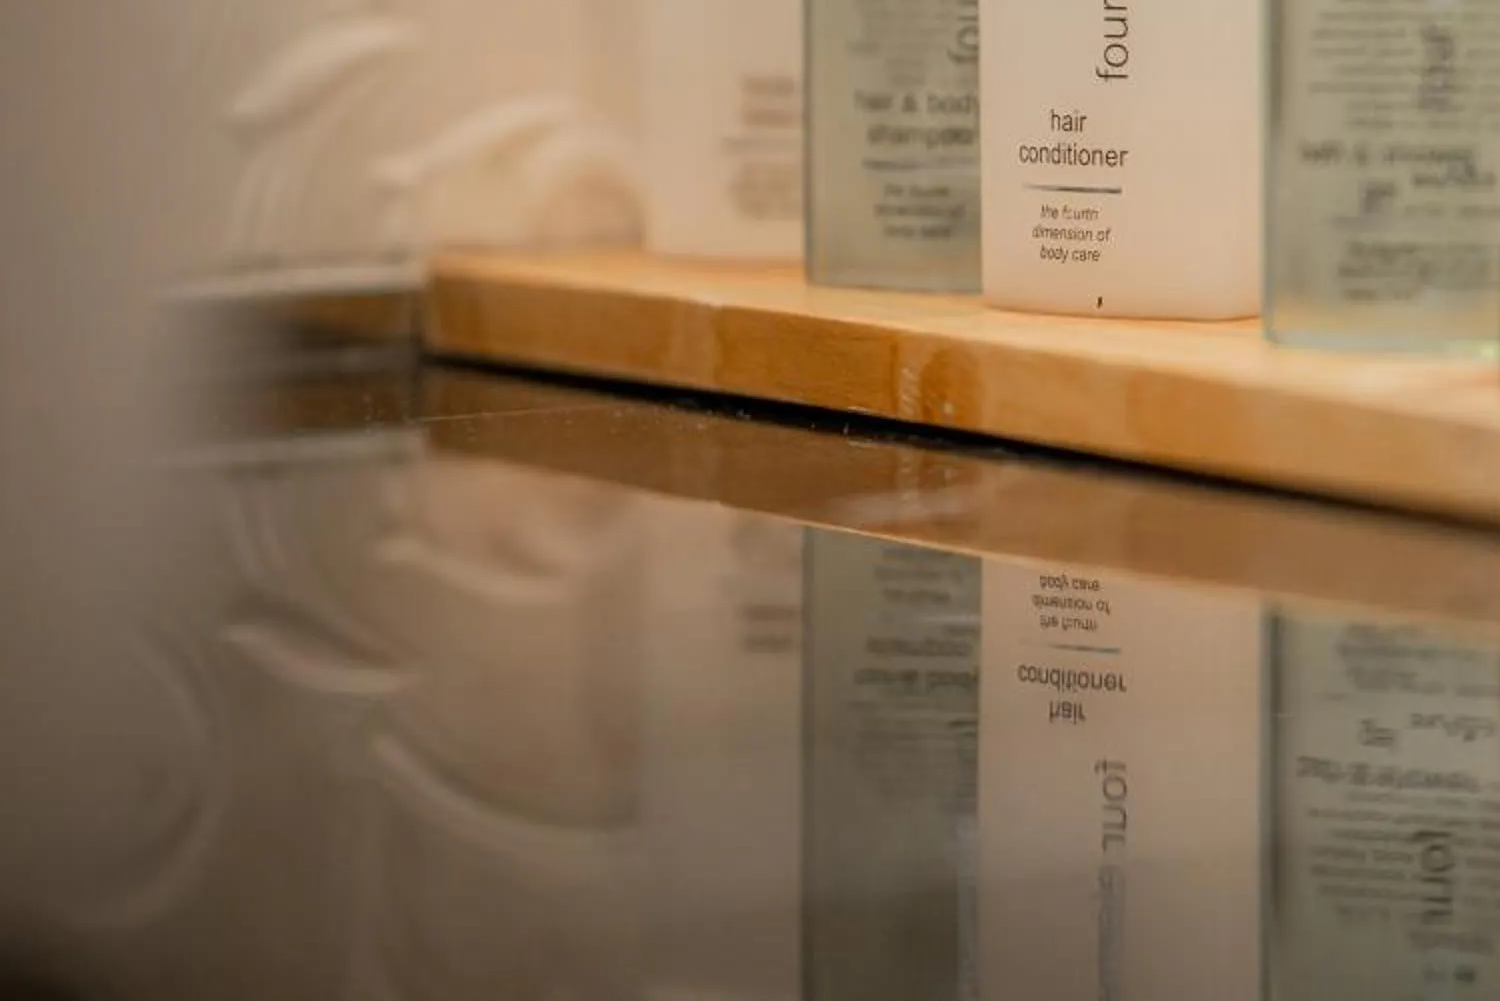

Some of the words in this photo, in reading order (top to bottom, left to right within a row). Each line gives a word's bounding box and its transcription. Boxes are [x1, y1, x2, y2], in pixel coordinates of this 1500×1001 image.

[1050, 109, 1087, 132] hair
[1019, 143, 1129, 167] conditioner
[1040, 204, 1059, 220] the
[1032, 224, 1093, 241] dimension
[1097, 228, 1111, 241] of
[1040, 244, 1069, 264] body
[1072, 249, 1101, 262] care
